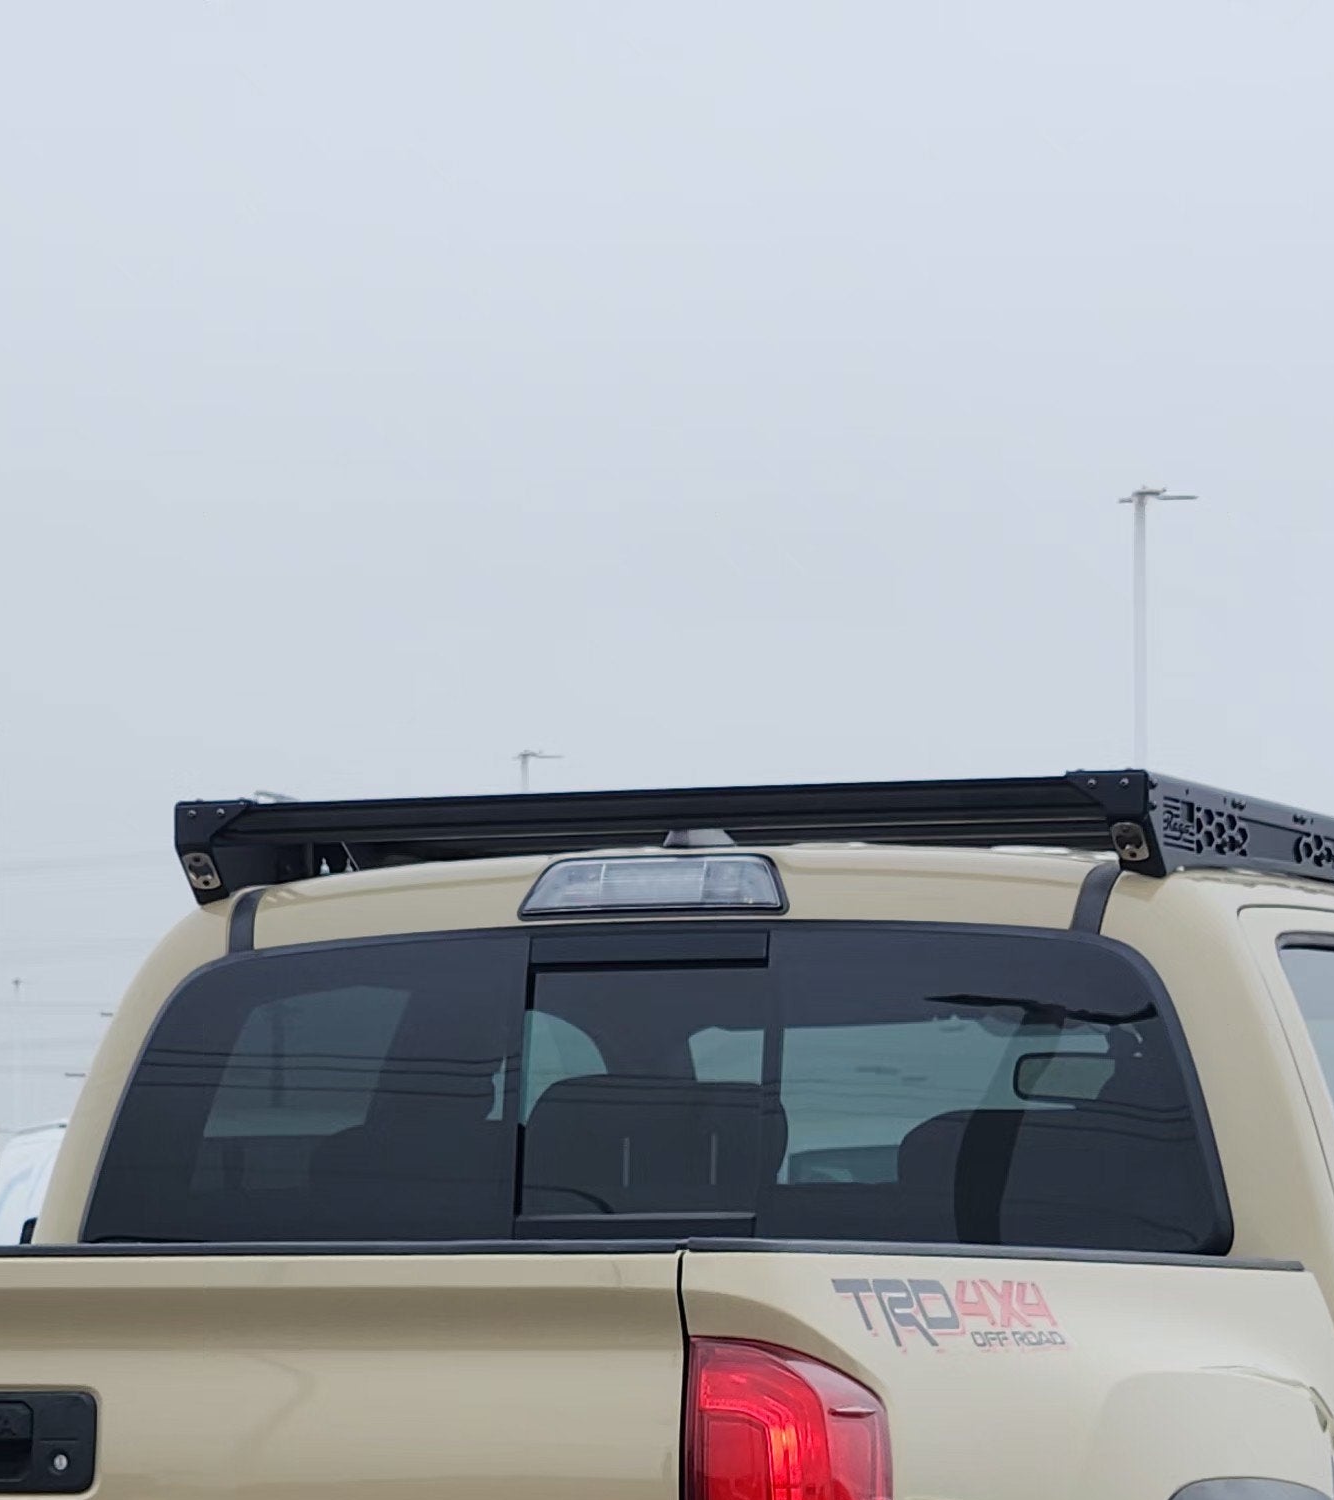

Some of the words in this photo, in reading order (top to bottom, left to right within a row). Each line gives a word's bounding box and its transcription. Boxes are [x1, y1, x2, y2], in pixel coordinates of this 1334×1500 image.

[831, 1279, 962, 1347] TRD
[971, 1331, 1008, 1347] OFF
[1012, 1331, 1066, 1346] ROAD
